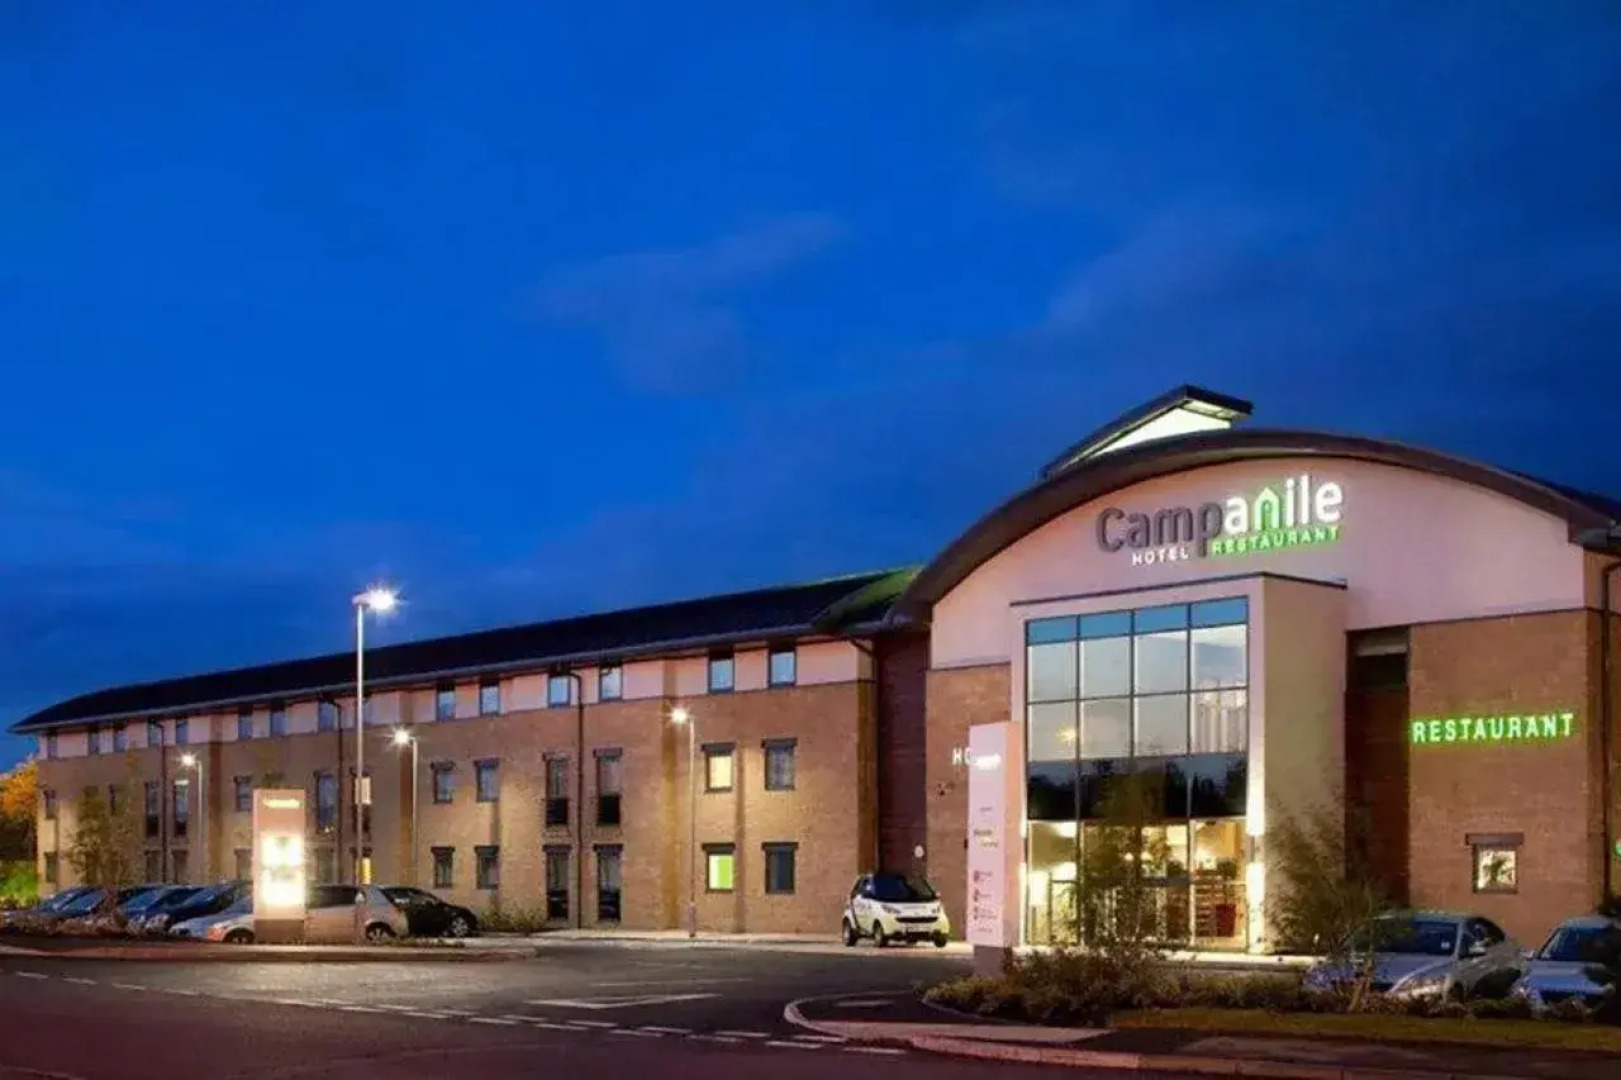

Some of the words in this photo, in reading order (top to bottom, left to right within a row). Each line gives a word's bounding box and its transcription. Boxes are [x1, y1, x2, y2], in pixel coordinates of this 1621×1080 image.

[1096, 474, 1344, 557] Campanile
[1131, 546, 1189, 567] HOTEL
[1212, 525, 1341, 555] RESTAURANT
[1411, 712, 1575, 743] RESTAURANT
